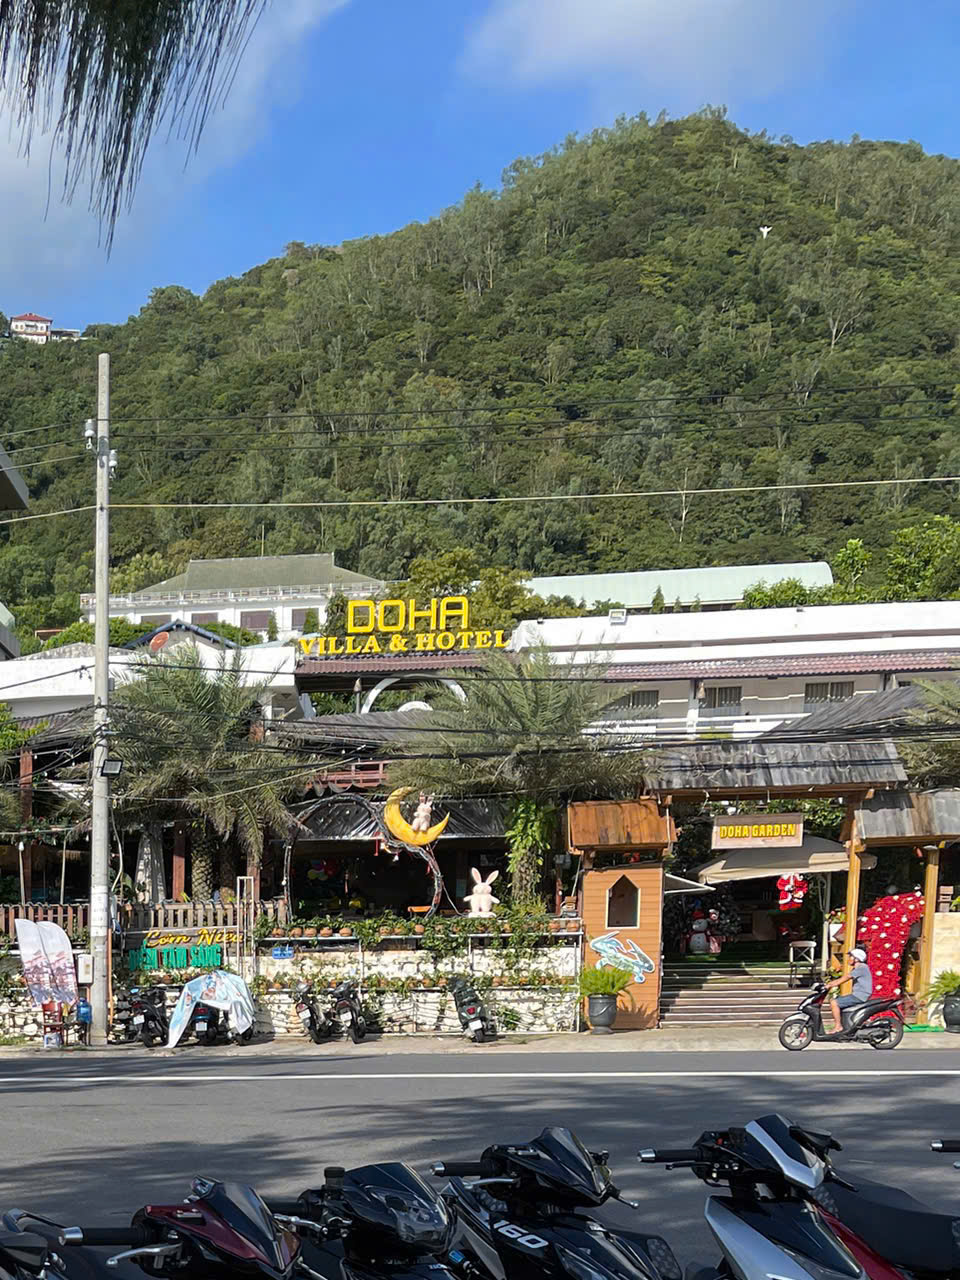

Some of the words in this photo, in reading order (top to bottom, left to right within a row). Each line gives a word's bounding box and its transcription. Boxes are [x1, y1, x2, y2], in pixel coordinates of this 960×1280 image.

[347, 596, 469, 634] DOHA
[298, 634, 382, 656] VILLA
[389, 634, 407, 652] &
[415, 629, 512, 652] HOTEL
[720, 824, 750, 839] DOHA
[752, 823, 796, 838] GARDEN
[493, 1219, 550, 1249] 160
